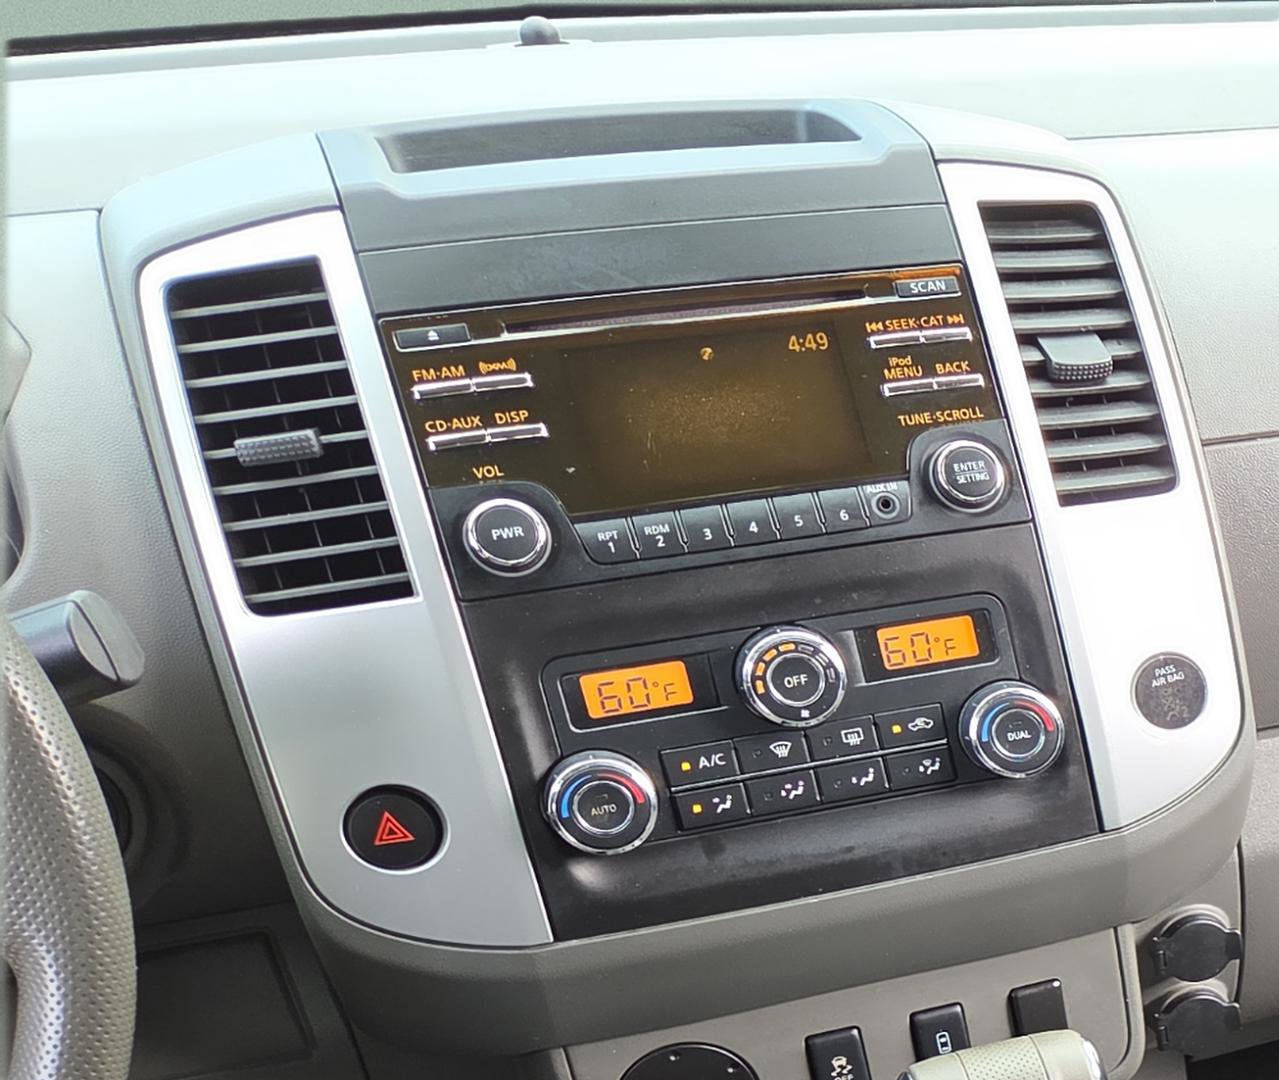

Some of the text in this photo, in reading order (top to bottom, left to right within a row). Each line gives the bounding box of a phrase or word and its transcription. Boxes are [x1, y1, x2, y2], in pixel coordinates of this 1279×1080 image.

[909, 279, 947, 294] SCAN
[788, 332, 829, 352] 4:49
[888, 355, 912, 368] iPod
[935, 361, 971, 375] BACK
[883, 365, 923, 380] MENU
[494, 409, 529, 425] DISP
[472, 464, 505, 480] VOL
[953, 460, 986, 473] ENTER
[956, 471, 991, 485] SETTING
[794, 514, 804, 527] 5
[839, 508, 850, 522] 6
[490, 526, 525, 541] PWR
[643, 523, 671, 536] RDM
[702, 527, 713, 541] 3
[748, 520, 759, 534] 4
[597, 530, 619, 542] RPT
[655, 535, 666, 548] 2
[607, 541, 616, 554] 1
[1154, 664, 1177, 678] PASS
[783, 673, 809, 689] OFF
[1151, 676, 1167, 688] AIR
[1007, 730, 1032, 742] DUAL
[698, 752, 727, 770] A/C
[590, 804, 618, 816] AUTO
